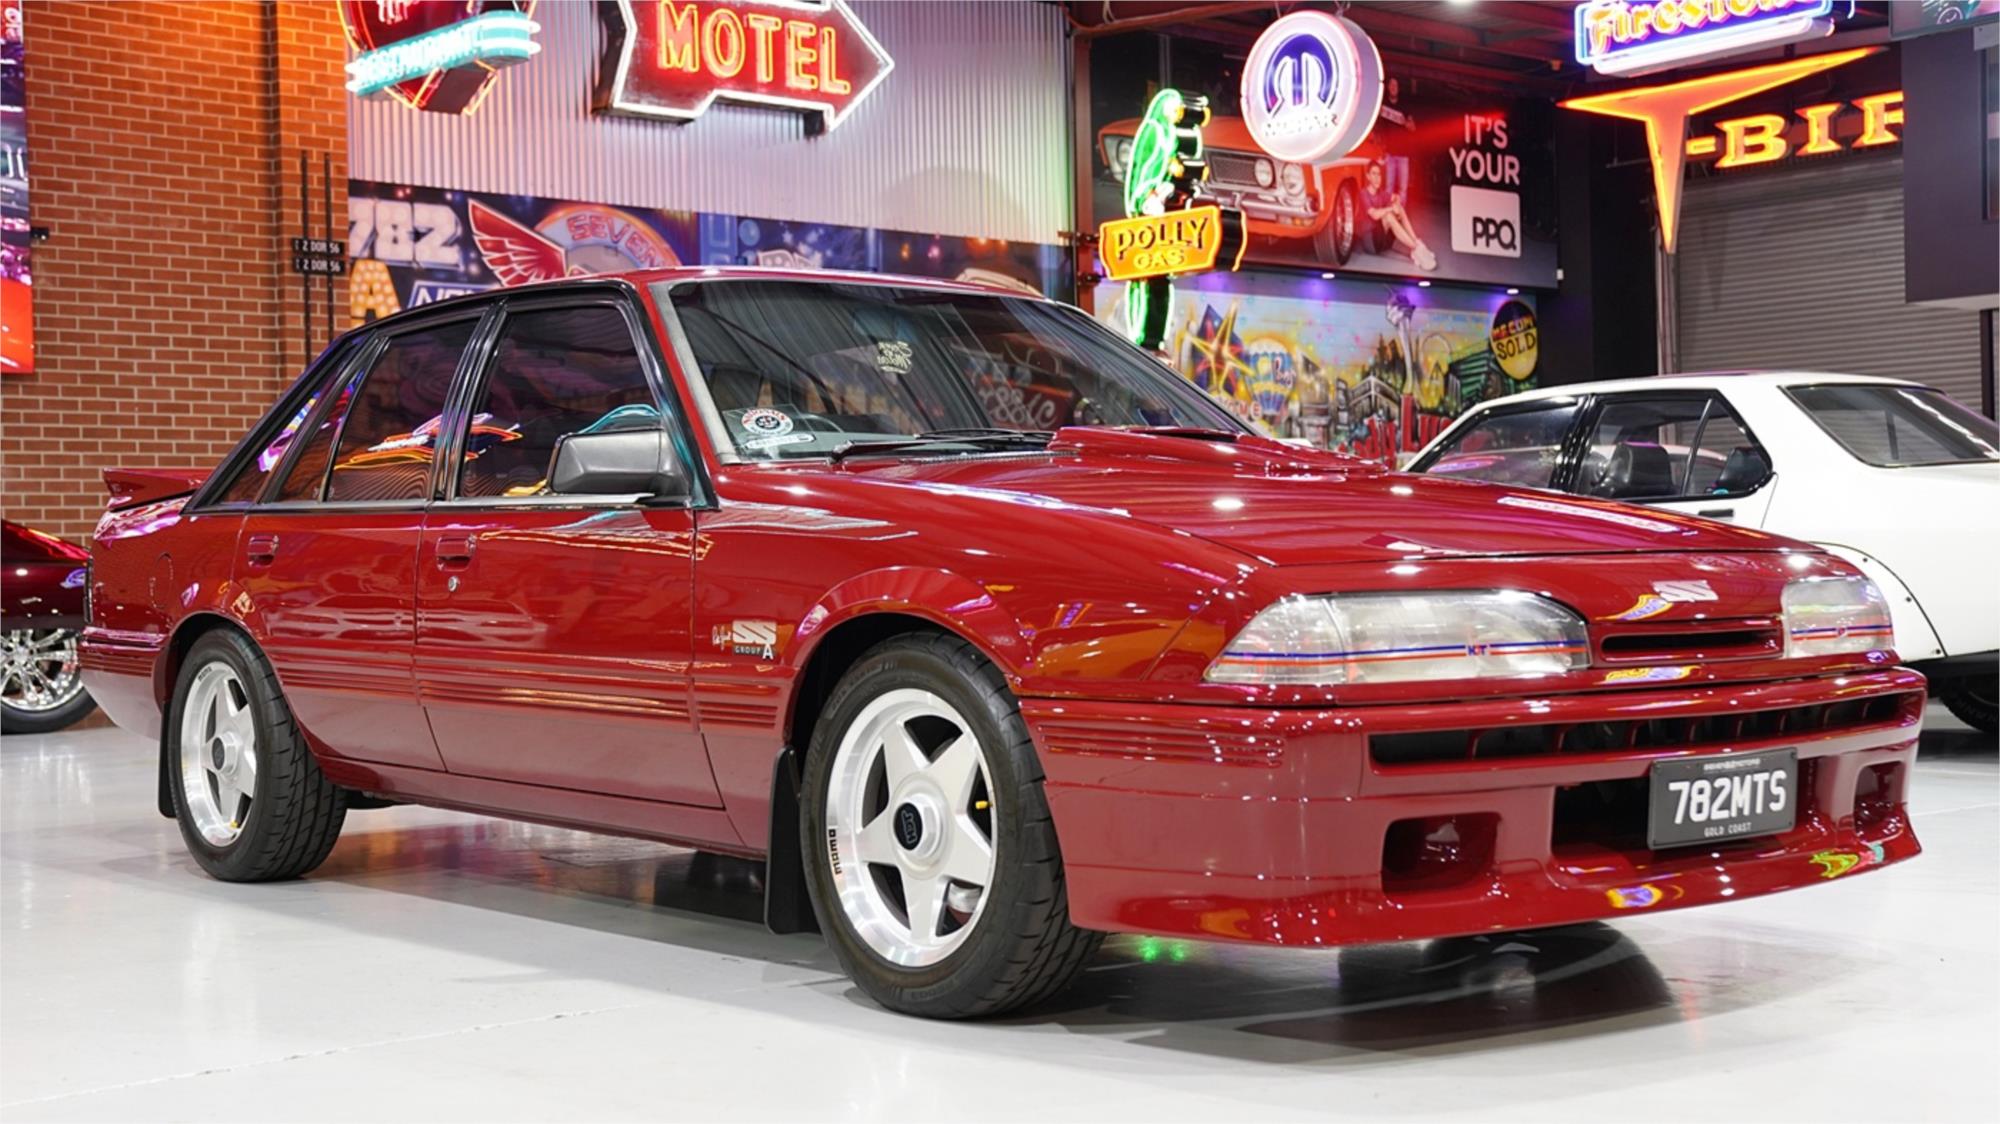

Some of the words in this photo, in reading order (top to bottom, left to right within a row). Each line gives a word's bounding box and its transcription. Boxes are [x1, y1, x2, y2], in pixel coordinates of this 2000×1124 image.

[657, 0, 851, 95] MOTEL
[1464, 114, 1508, 149] IT'S
[1449, 147, 1520, 186] YOUR
[349, 197, 465, 271] 782
[1115, 217, 1208, 260] POLLY
[1472, 216, 1517, 251] PPQ
[1133, 249, 1185, 269] GAS
[1495, 332, 1537, 360] SOLD
[762, 645, 774, 660] A
[1668, 769, 1788, 825] 782MTS
[1703, 825, 1725, 838] GOLD
[1728, 821, 1752, 835] COAST
